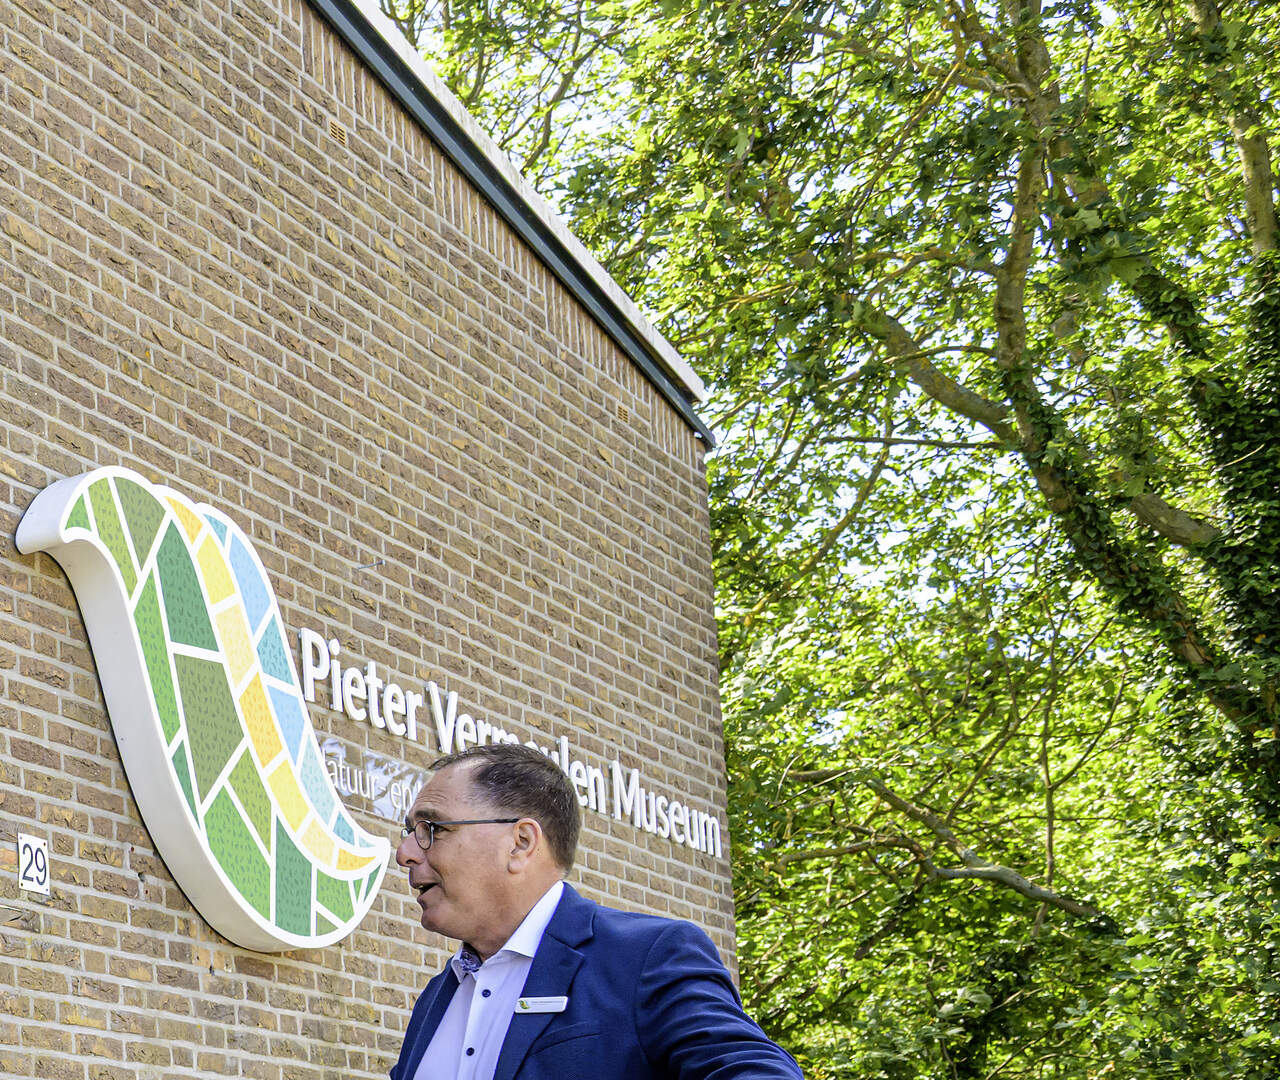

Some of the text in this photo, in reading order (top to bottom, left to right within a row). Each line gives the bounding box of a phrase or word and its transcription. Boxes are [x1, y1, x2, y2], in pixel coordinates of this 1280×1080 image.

[300, 627, 721, 858] Pieter Verlen Museum
[22, 843, 47, 885] 29
